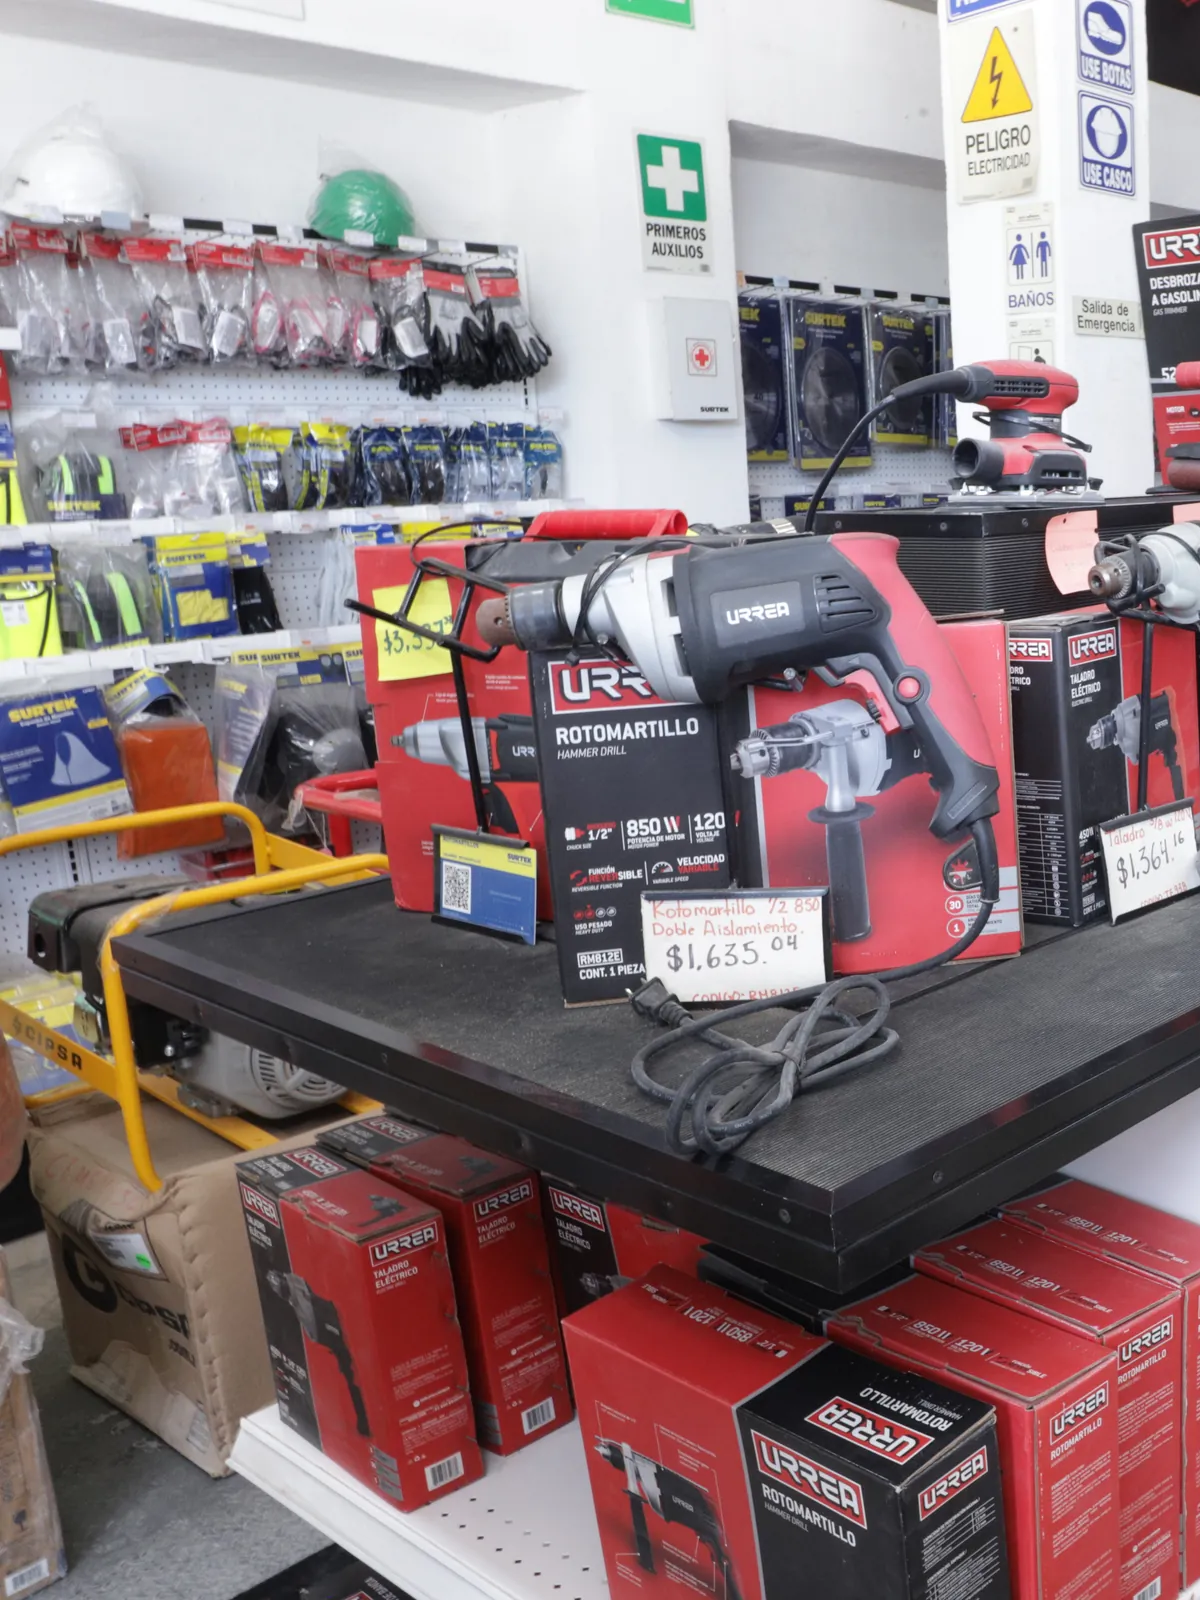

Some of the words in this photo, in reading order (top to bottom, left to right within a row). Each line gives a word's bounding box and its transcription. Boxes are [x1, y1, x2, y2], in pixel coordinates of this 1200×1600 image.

[1082, 55, 1100, 77] USE
[1102, 62, 1131, 89] BOTAS
[966, 125, 1031, 154] PELIGRO
[968, 152, 1031, 176] ELECTRICIDAD
[1083, 160, 1102, 185] USE
[1103, 166, 1131, 191] CASCO
[646, 223, 706, 241] PRIMEROS
[652, 242, 703, 259] AUXILIOS
[1008, 290, 1054, 308] BAÑOS
[1082, 299, 1112, 315] Salida
[1117, 303, 1128, 316] de
[1152, 295, 1159, 306] A
[805, 312, 846, 328] SURTEK
[1077, 315, 1135, 333] Emergencia
[166, 553, 206, 564] SURTEK
[727, 602, 790, 625] URREA
[1072, 632, 1115, 659] URREA
[261, 651, 300, 663] SURTEK
[562, 667, 652, 702] URR
[1070, 669, 1095, 684] TALADRO
[1071, 682, 1101, 700] ELÉCTRICO
[8, 697, 78, 723] SURTEK
[555, 717, 699, 745] ROTOMARTILLO
[557, 747, 598, 760] HAMMER
[600, 745, 627, 757] DRILL
[626, 818, 661, 837] 850
[694, 812, 726, 831] 120
[588, 829, 612, 841] 1/2"
[627, 837, 655, 845] POTENCIA
[665, 834, 685, 842] MOTOR
[677, 854, 725, 866] VELOCIDAD
[678, 863, 719, 874] VARIABLE
[588, 865, 615, 875] FUNCIÓN
[588, 869, 643, 883] REVERSIBLE
[795, 898, 820, 914] 850
[949, 901, 961, 909] 30
[575, 923, 587, 931] USO
[588, 920, 612, 929] PESADO
[652, 921, 695, 937] Doble
[954, 924, 960, 932] 1
[580, 953, 621, 966] RM812E
[579, 967, 607, 980] CONT.
[609, 965, 616, 976] 1
[617, 963, 645, 976] PIEZA
[25, 1025, 82, 1070] CIPSA
[369, 1119, 420, 1140] URREA
[294, 1151, 340, 1177] URREA
[243, 1187, 277, 1223] URREA
[478, 1184, 531, 1216] URREA
[552, 1192, 602, 1225] URREA
[477, 1216, 508, 1234] TALADRO
[478, 1222, 516, 1244] ELÉCTRICO
[555, 1218, 583, 1236] TALADRO
[1070, 1215, 1094, 1229] 850
[1107, 1231, 1131, 1245] 120
[374, 1227, 435, 1260] URREA
[558, 1230, 591, 1249] ELÉCTRICO
[374, 1260, 409, 1279] TALADRO
[375, 1266, 418, 1289] ELÉCTRICO
[990, 1259, 1014, 1275] 850
[1029, 1276, 1054, 1290] 120
[691, 1309, 715, 1324] 120
[729, 1326, 753, 1342] 850
[913, 1320, 940, 1336] 850
[954, 1338, 982, 1353] 120
[1122, 1321, 1171, 1363] URREA
[1118, 1349, 1166, 1384] ROTOMARTILLO
[860, 1387, 952, 1431] ROTOMARTILLO
[1054, 1388, 1106, 1437] URREA
[818, 1405, 917, 1456] URREA
[1051, 1418, 1102, 1460] ROTOMARTILLO
[760, 1446, 860, 1518] URREA
[923, 1455, 985, 1510] URREA
[672, 1496, 694, 1512] URREA
[762, 1484, 856, 1547] ROTOMARTILLO
[764, 1502, 790, 1523] HAMMER
[789, 1514, 809, 1532] DRILL
